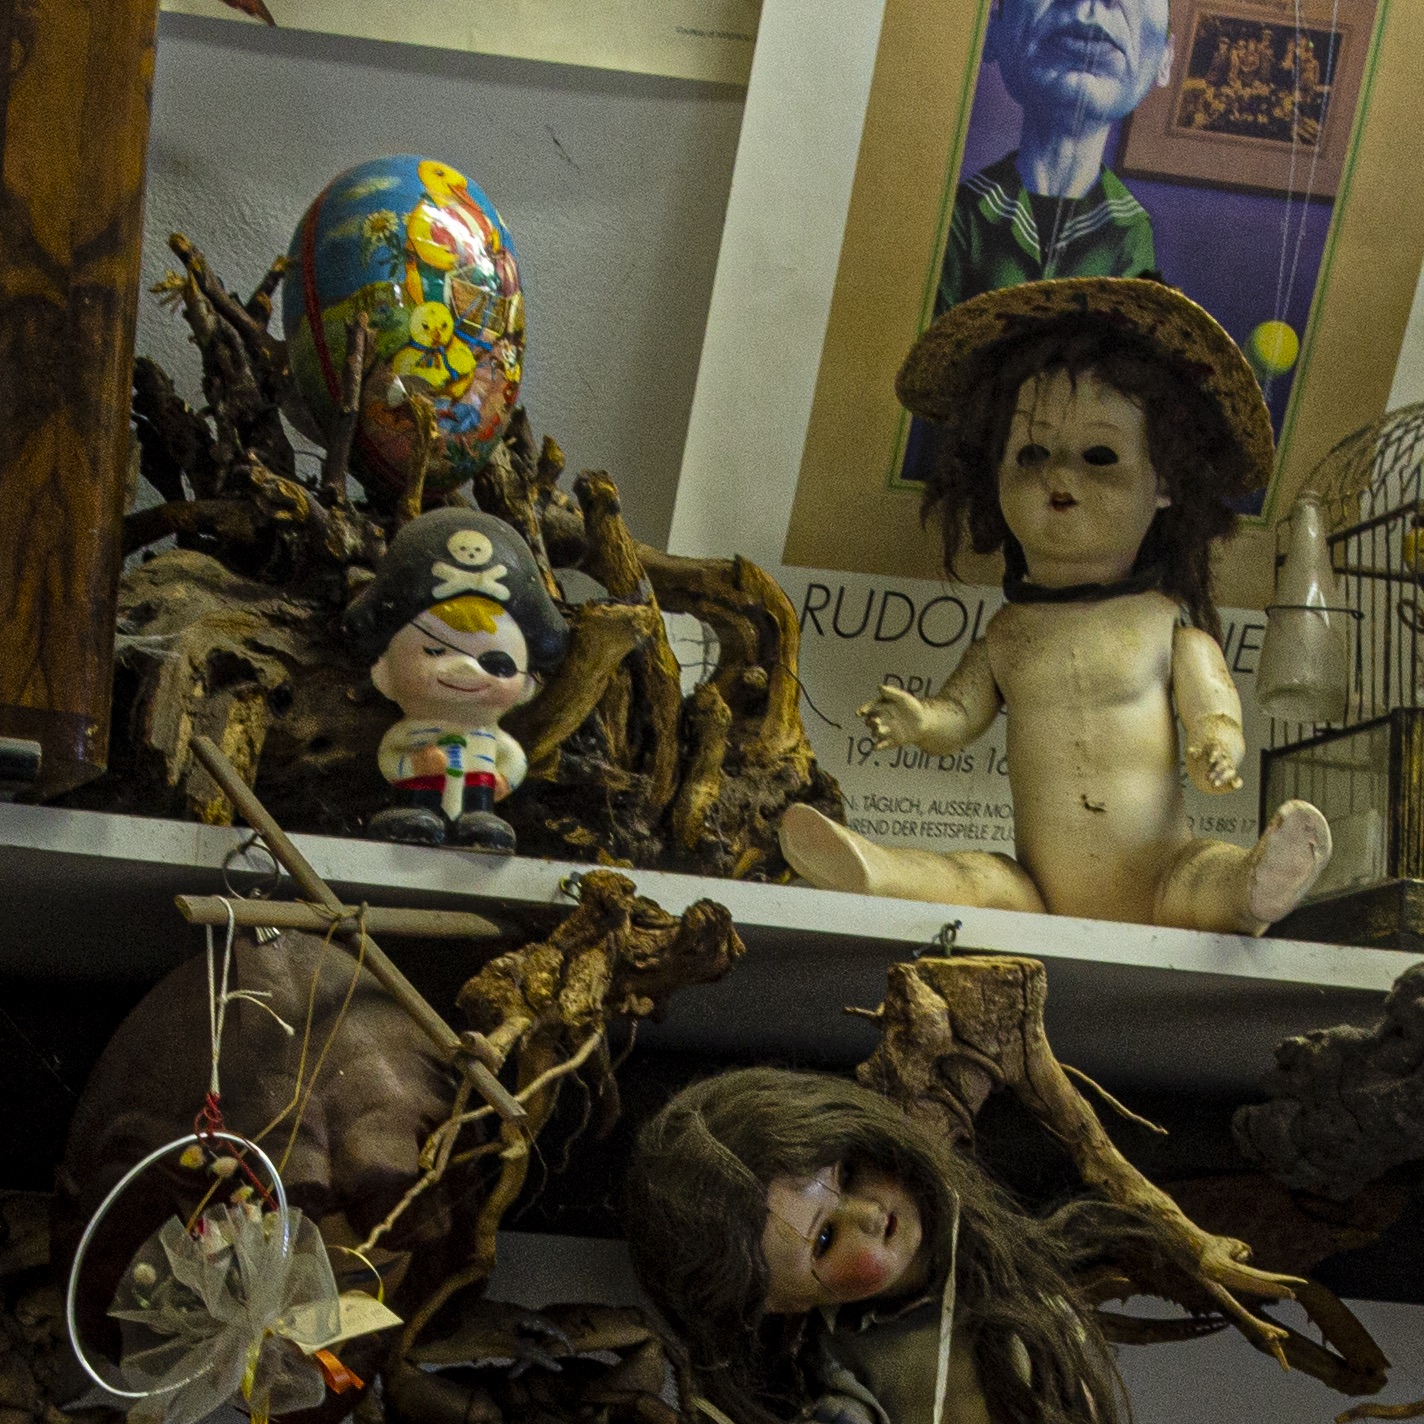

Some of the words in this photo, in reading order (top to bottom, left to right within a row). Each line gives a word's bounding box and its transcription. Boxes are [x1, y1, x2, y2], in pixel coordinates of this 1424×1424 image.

[846, 735, 880, 768] 19.
[927, 799, 981, 817] AUSSER
[892, 819, 918, 835] DER
[920, 822, 988, 841] FESTSPIELE
